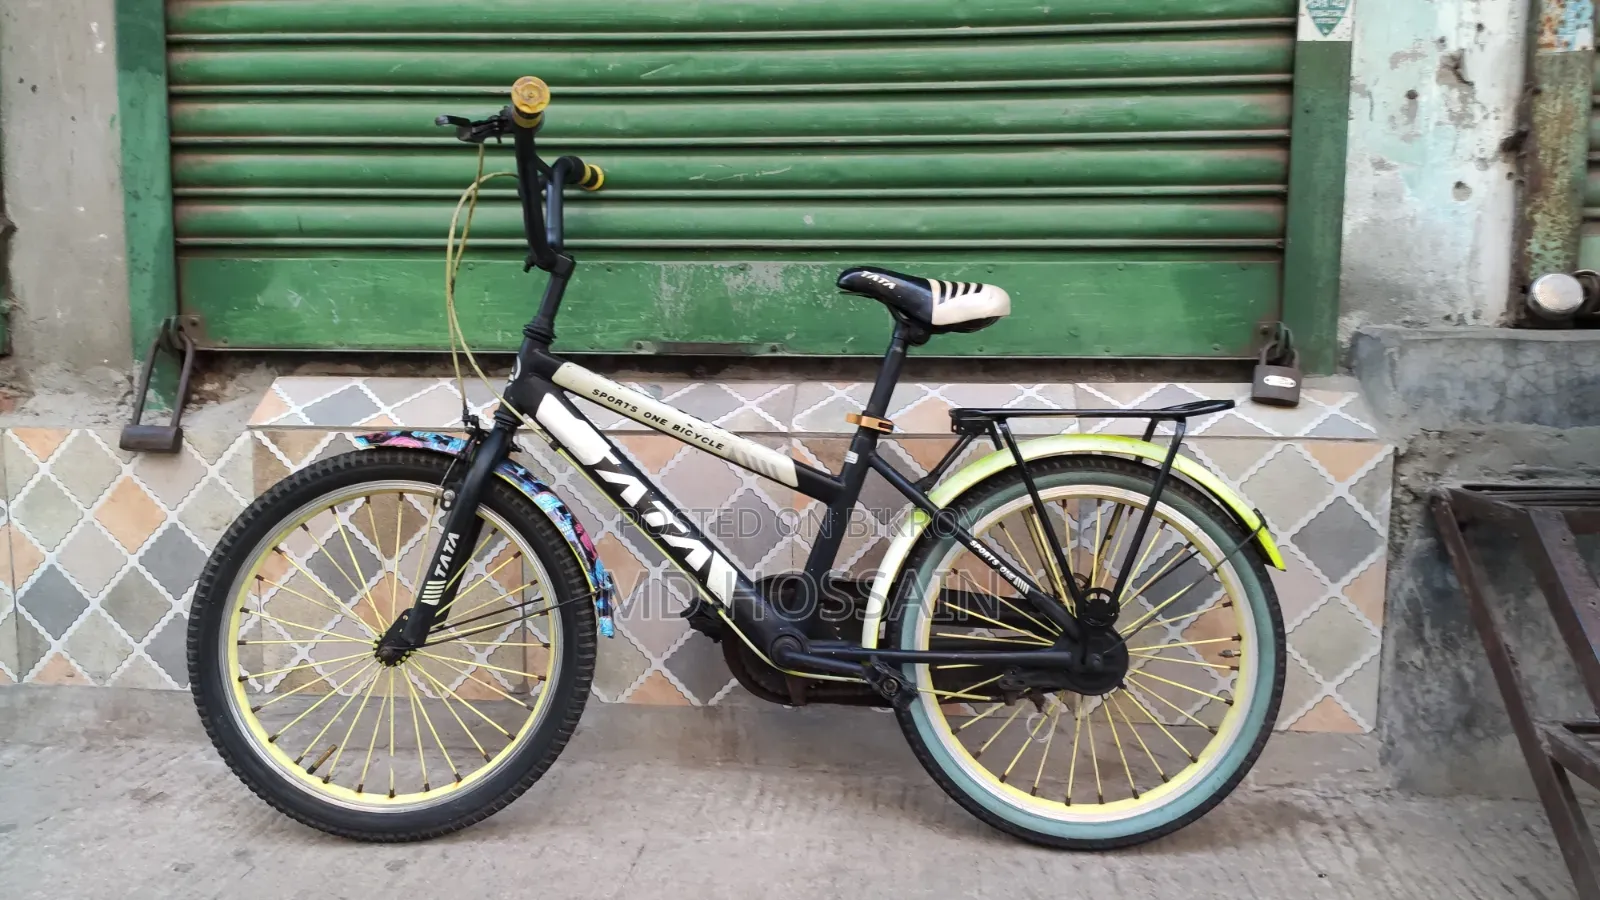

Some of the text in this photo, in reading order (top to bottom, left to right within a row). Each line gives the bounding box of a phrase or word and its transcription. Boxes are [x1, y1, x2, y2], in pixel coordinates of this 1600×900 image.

[860, 271, 896, 290] TATA
[592, 388, 725, 451] SPORTS ONE BICYCLE
[435, 532, 460, 578] TATA
[970, 540, 1000, 566] SPORTS
